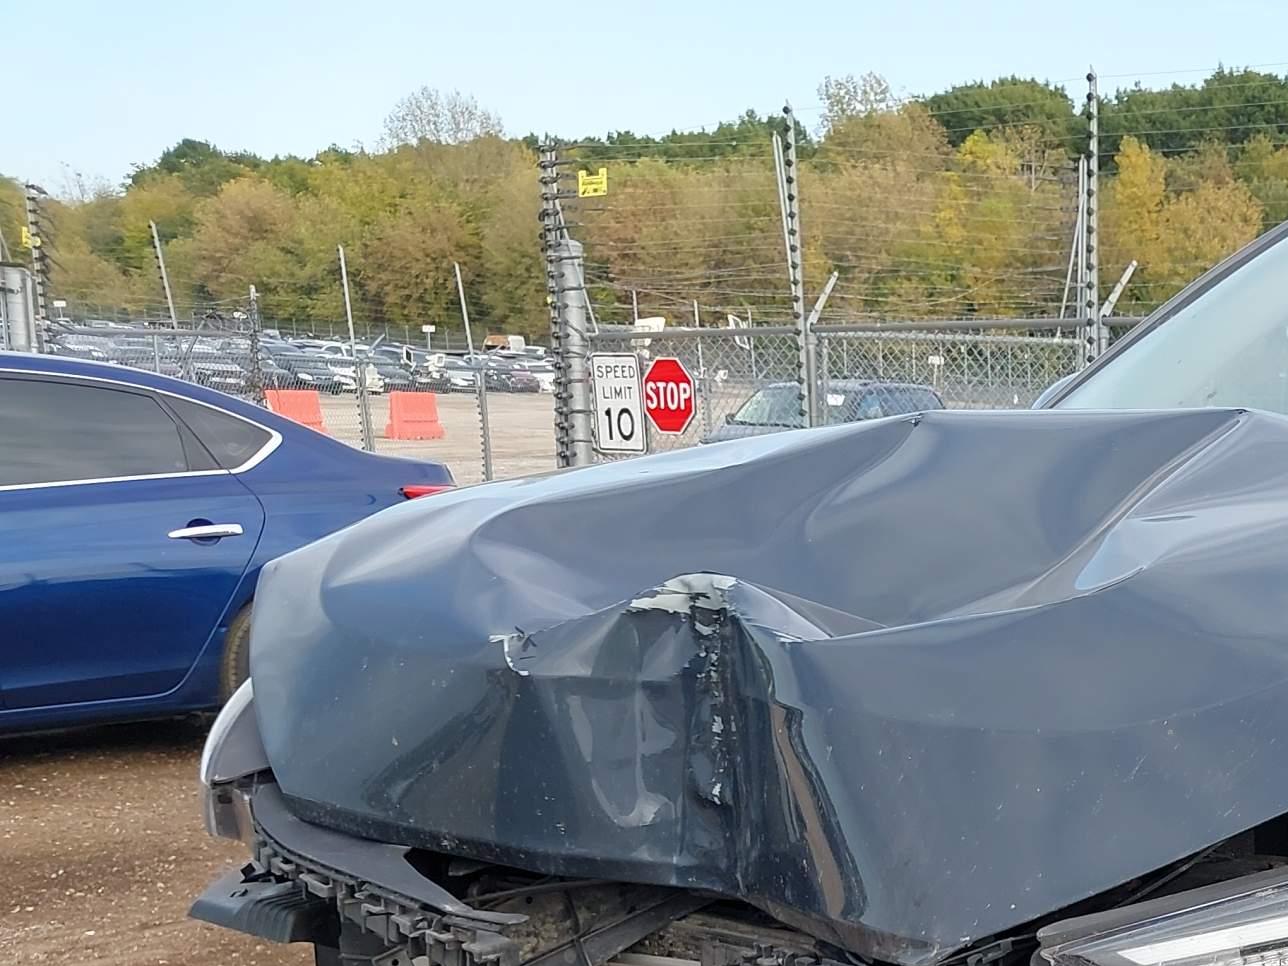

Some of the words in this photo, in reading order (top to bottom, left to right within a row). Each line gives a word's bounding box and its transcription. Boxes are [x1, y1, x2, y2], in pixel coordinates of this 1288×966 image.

[596, 365, 636, 379] SPEED
[602, 386, 633, 400] LIMIT
[645, 381, 691, 411] STOP
[604, 407, 635, 441] 10
